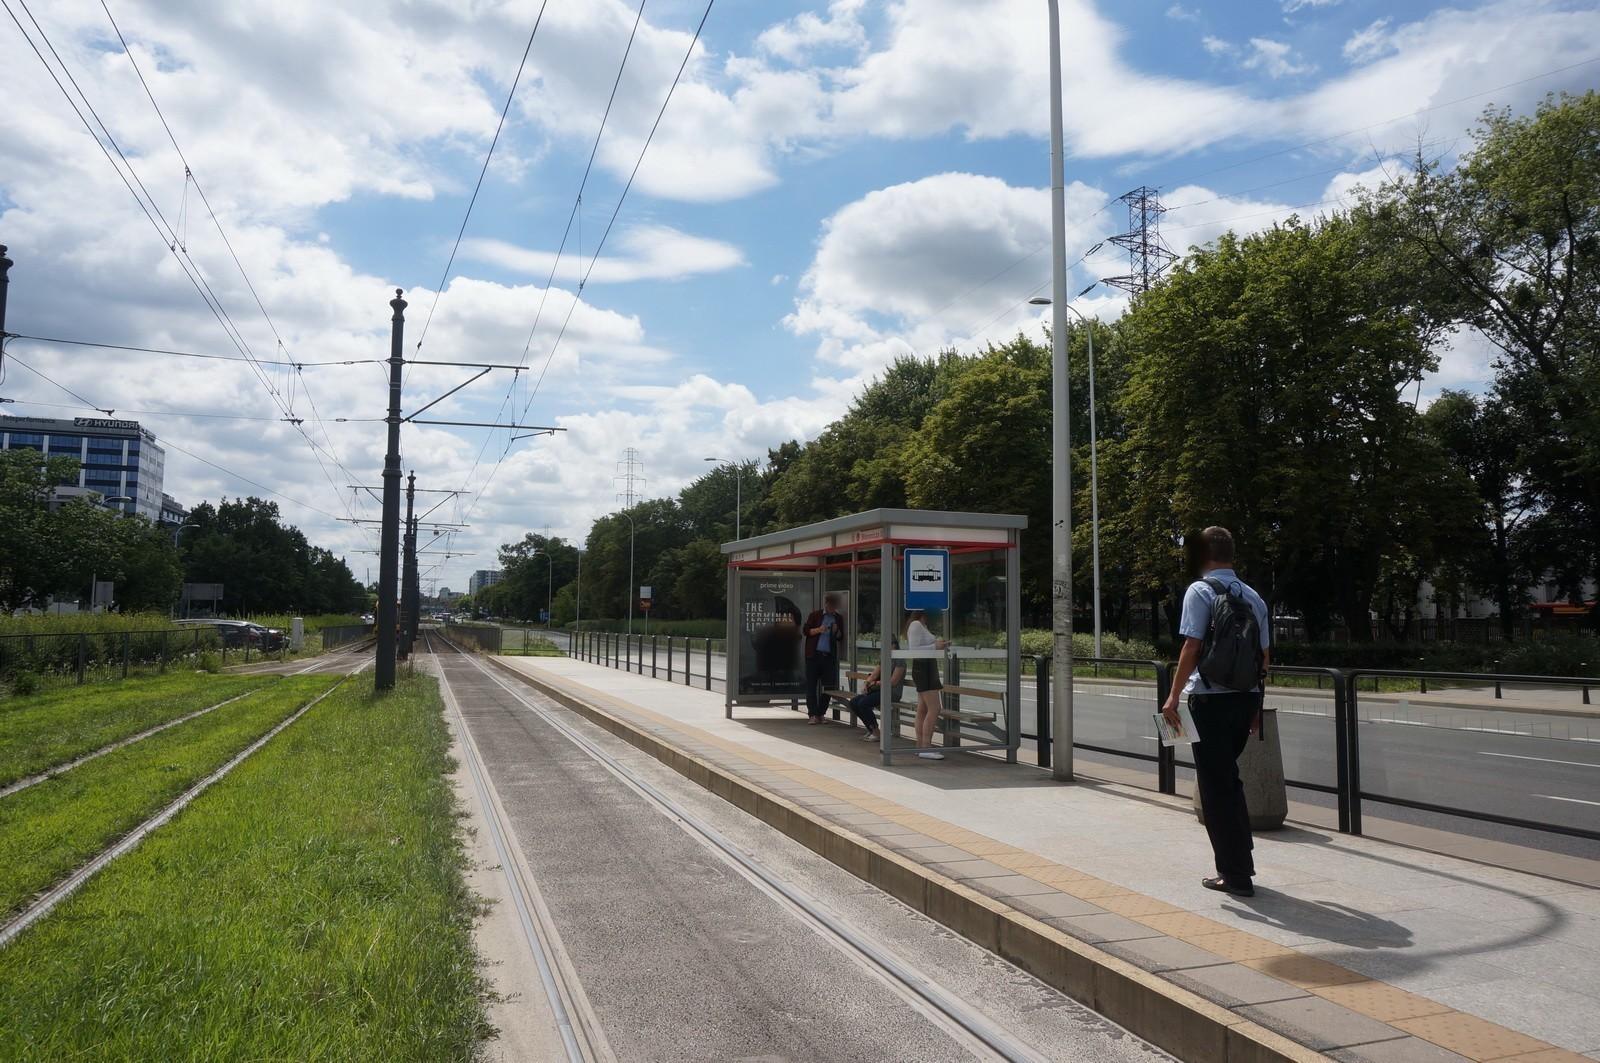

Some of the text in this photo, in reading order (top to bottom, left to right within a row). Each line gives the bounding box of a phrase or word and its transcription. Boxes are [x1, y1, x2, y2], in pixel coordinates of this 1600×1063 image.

[94, 420, 138, 429] HYUNDAI
[760, 582, 777, 590] prime
[745, 602, 763, 612] THE
[745, 612, 793, 622] TERMINAL
